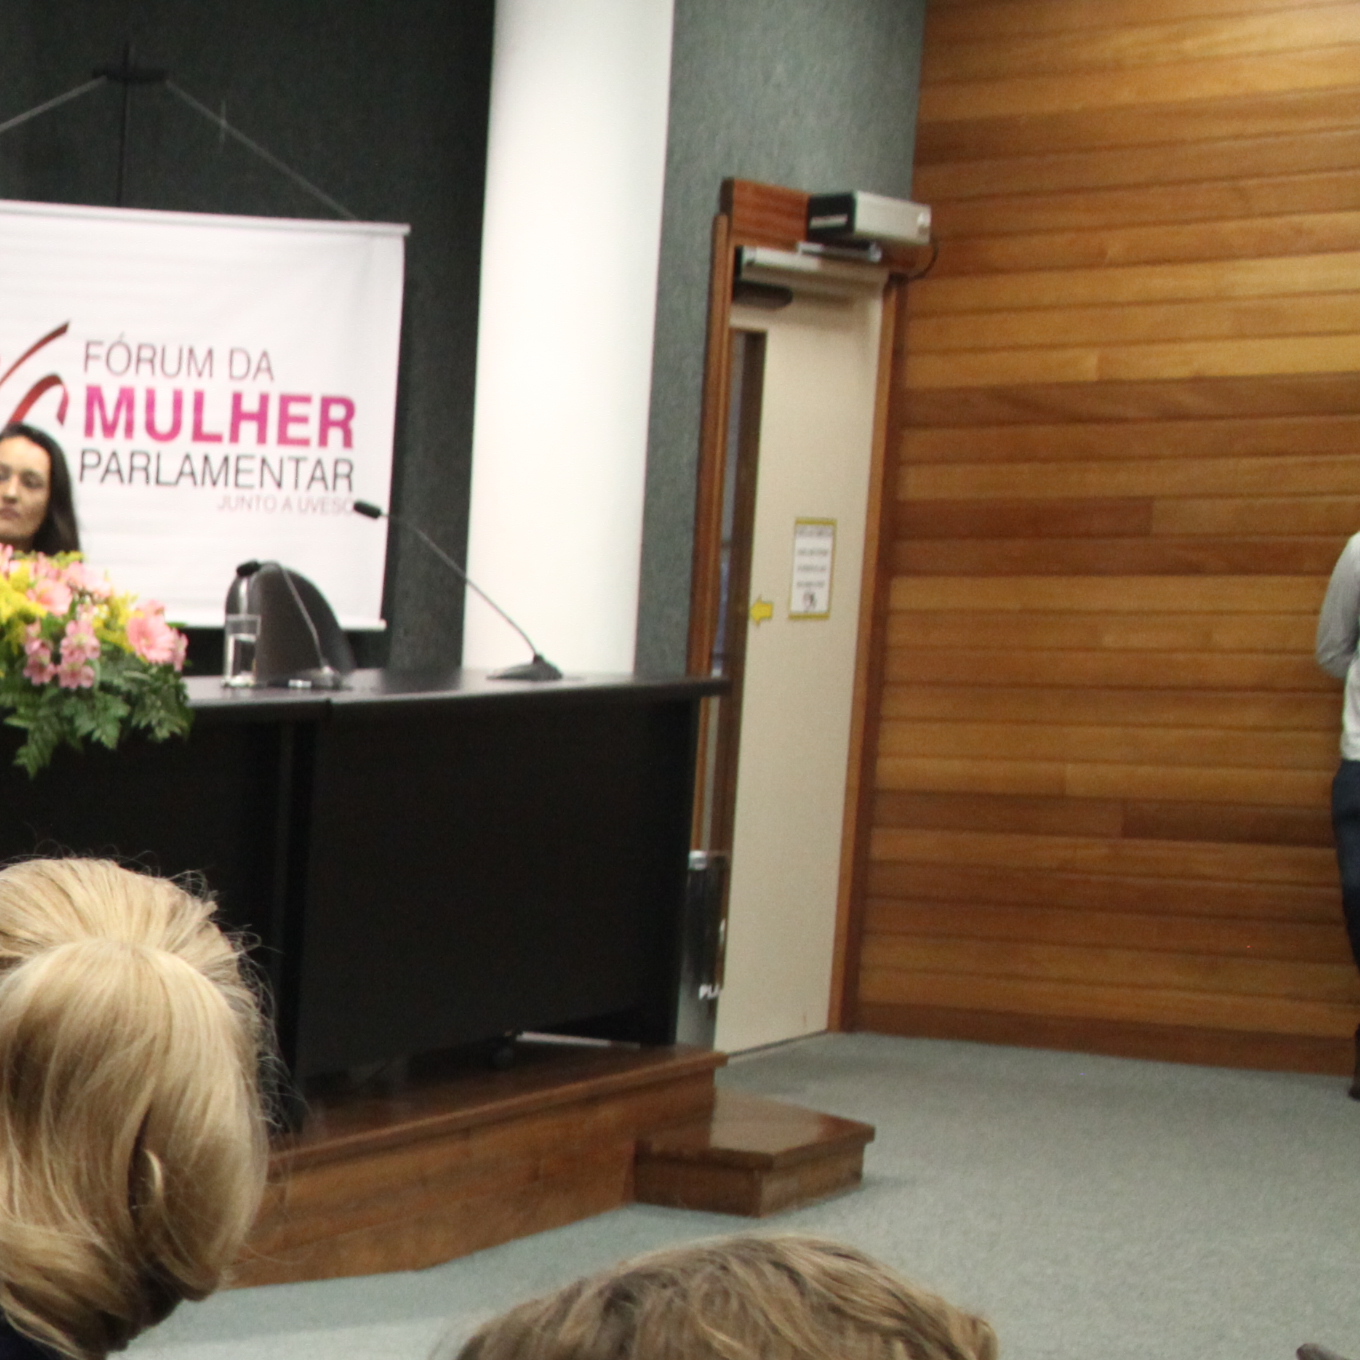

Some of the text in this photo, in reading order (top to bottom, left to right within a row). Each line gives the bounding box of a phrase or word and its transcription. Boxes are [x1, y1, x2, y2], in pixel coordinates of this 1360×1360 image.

[84, 331, 275, 382] FÓRUM DA
[84, 384, 356, 450] MULHER
[80, 449, 355, 493] PARLAMENTAR
